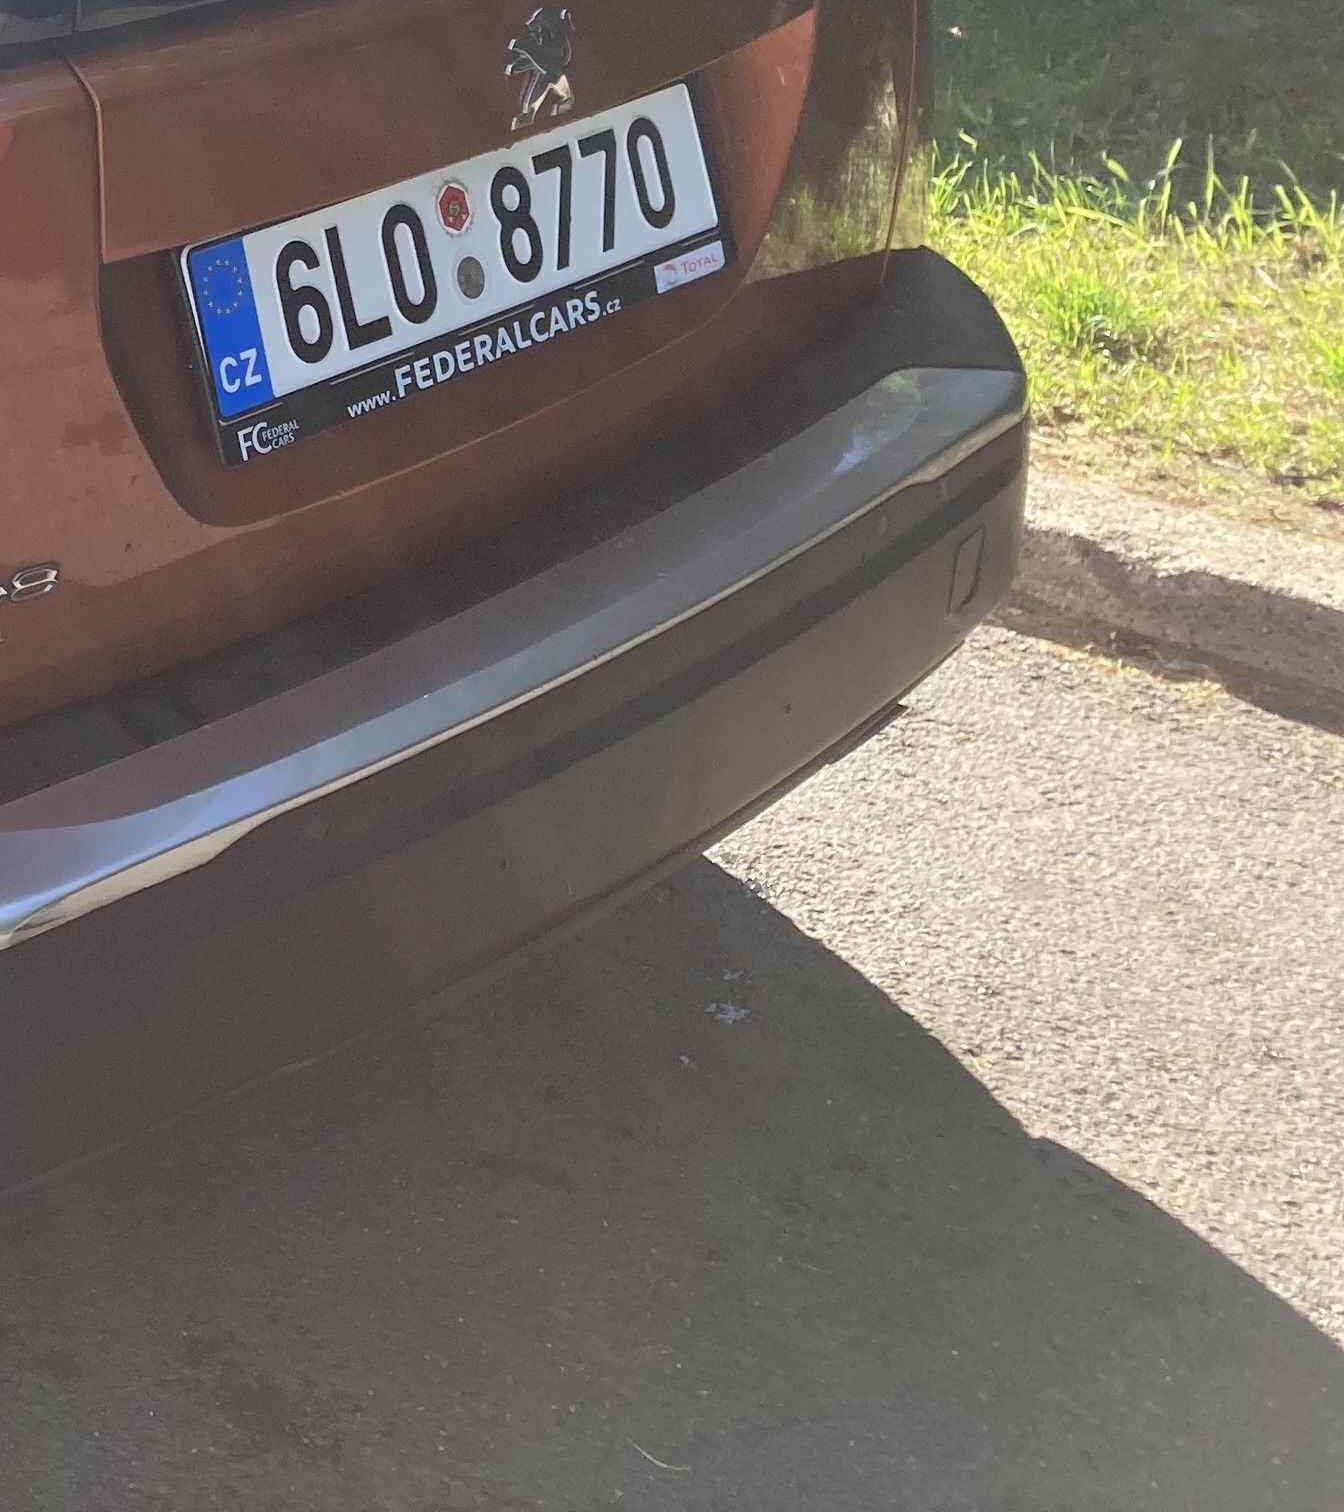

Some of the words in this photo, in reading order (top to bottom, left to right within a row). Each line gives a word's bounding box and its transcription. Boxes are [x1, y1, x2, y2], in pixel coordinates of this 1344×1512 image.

[491, 117, 675, 284] 8770
[681, 253, 719, 274] TOTAL
[220, 347, 263, 394] CZ
[346, 290, 622, 419] www.FEDERALCARS.cz
[237, 421, 273, 462] FC
[262, 419, 300, 442] FEDERAL
[272, 432, 295, 449] CARS
